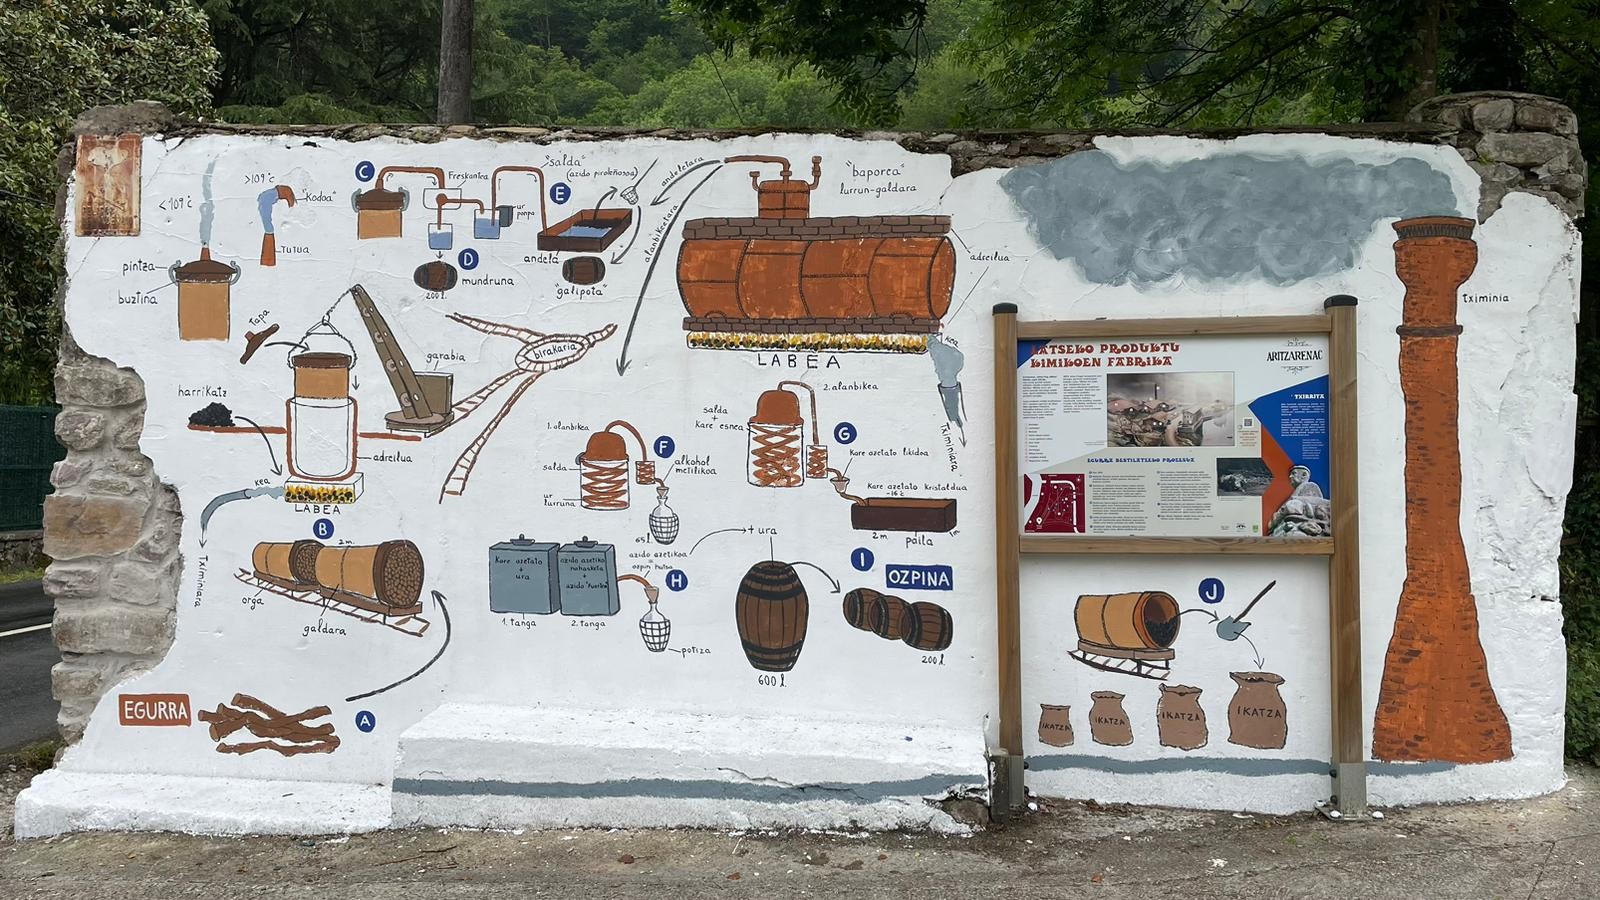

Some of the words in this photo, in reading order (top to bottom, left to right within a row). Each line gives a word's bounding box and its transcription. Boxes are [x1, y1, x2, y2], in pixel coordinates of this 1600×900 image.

[359, 165, 368, 179] C
[556, 187, 565, 201] E
[463, 253, 474, 266] D
[123, 260, 155, 276] pintza
[461, 274, 515, 286] mundruna
[118, 291, 158, 305] buztina
[1100, 342, 1180, 354] PRODUKTU
[426, 351, 466, 363] garabia
[758, 353, 841, 370] LABEA
[1107, 356, 1172, 367] FABRIKA
[1266, 350, 1323, 362] ARITZARENAC
[703, 404, 728, 414] salda
[838, 427, 850, 439] G
[659, 441, 668, 454] F
[294, 504, 341, 515] LABEA
[318, 523, 328, 536] B
[758, 526, 777, 535] ura
[906, 535, 933, 549] paila
[671, 574, 682, 588] H
[888, 569, 950, 586] OZPINA
[1205, 583, 1218, 600] J
[242, 595, 264, 612] orga
[303, 620, 347, 637] galdara
[124, 700, 188, 720] EGURRA
[1162, 710, 1200, 722] IKATZA
[1238, 706, 1282, 718] IKATZA
[360, 715, 371, 726] A
[1041, 722, 1071, 731] IKATZA
[1095, 716, 1125, 727] IKATZA
